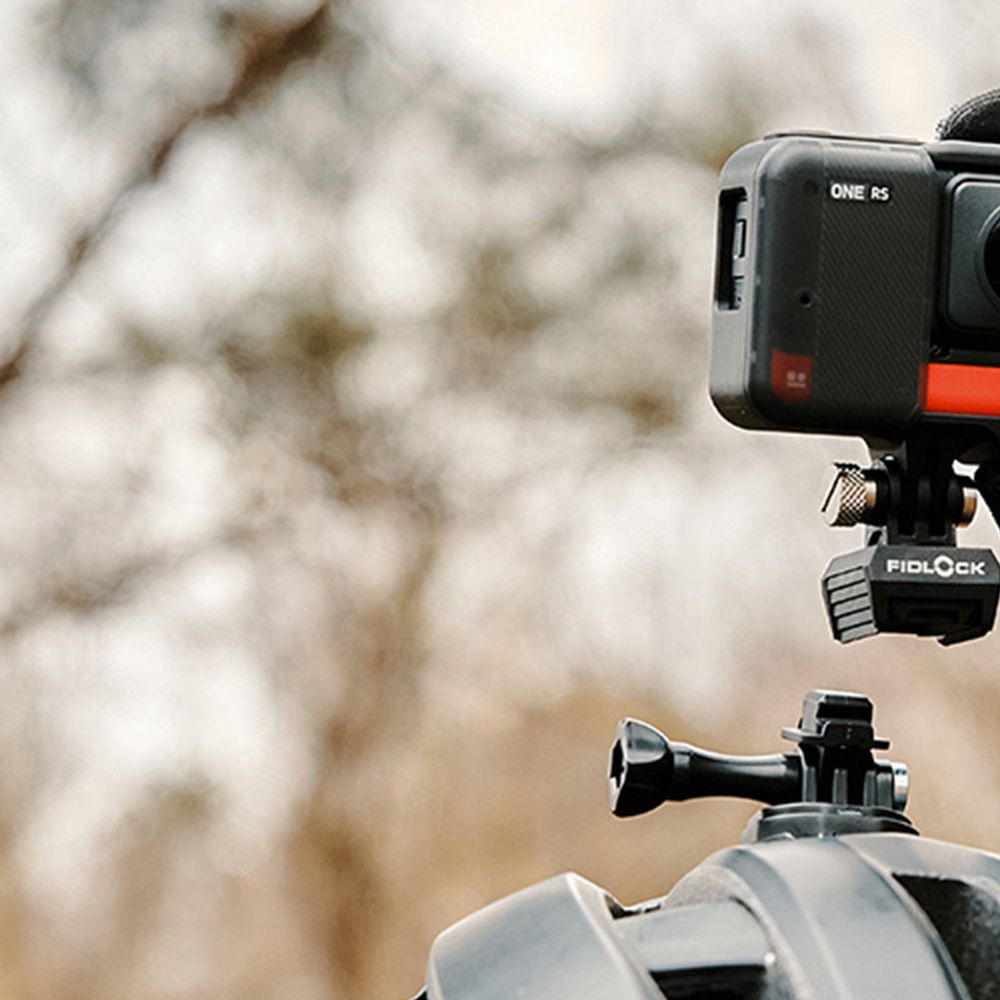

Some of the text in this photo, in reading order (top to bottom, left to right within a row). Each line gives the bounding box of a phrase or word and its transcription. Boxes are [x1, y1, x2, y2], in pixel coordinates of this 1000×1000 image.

[831, 183, 889, 201] ONE RS
[887, 555, 986, 578] FIDLOCK
